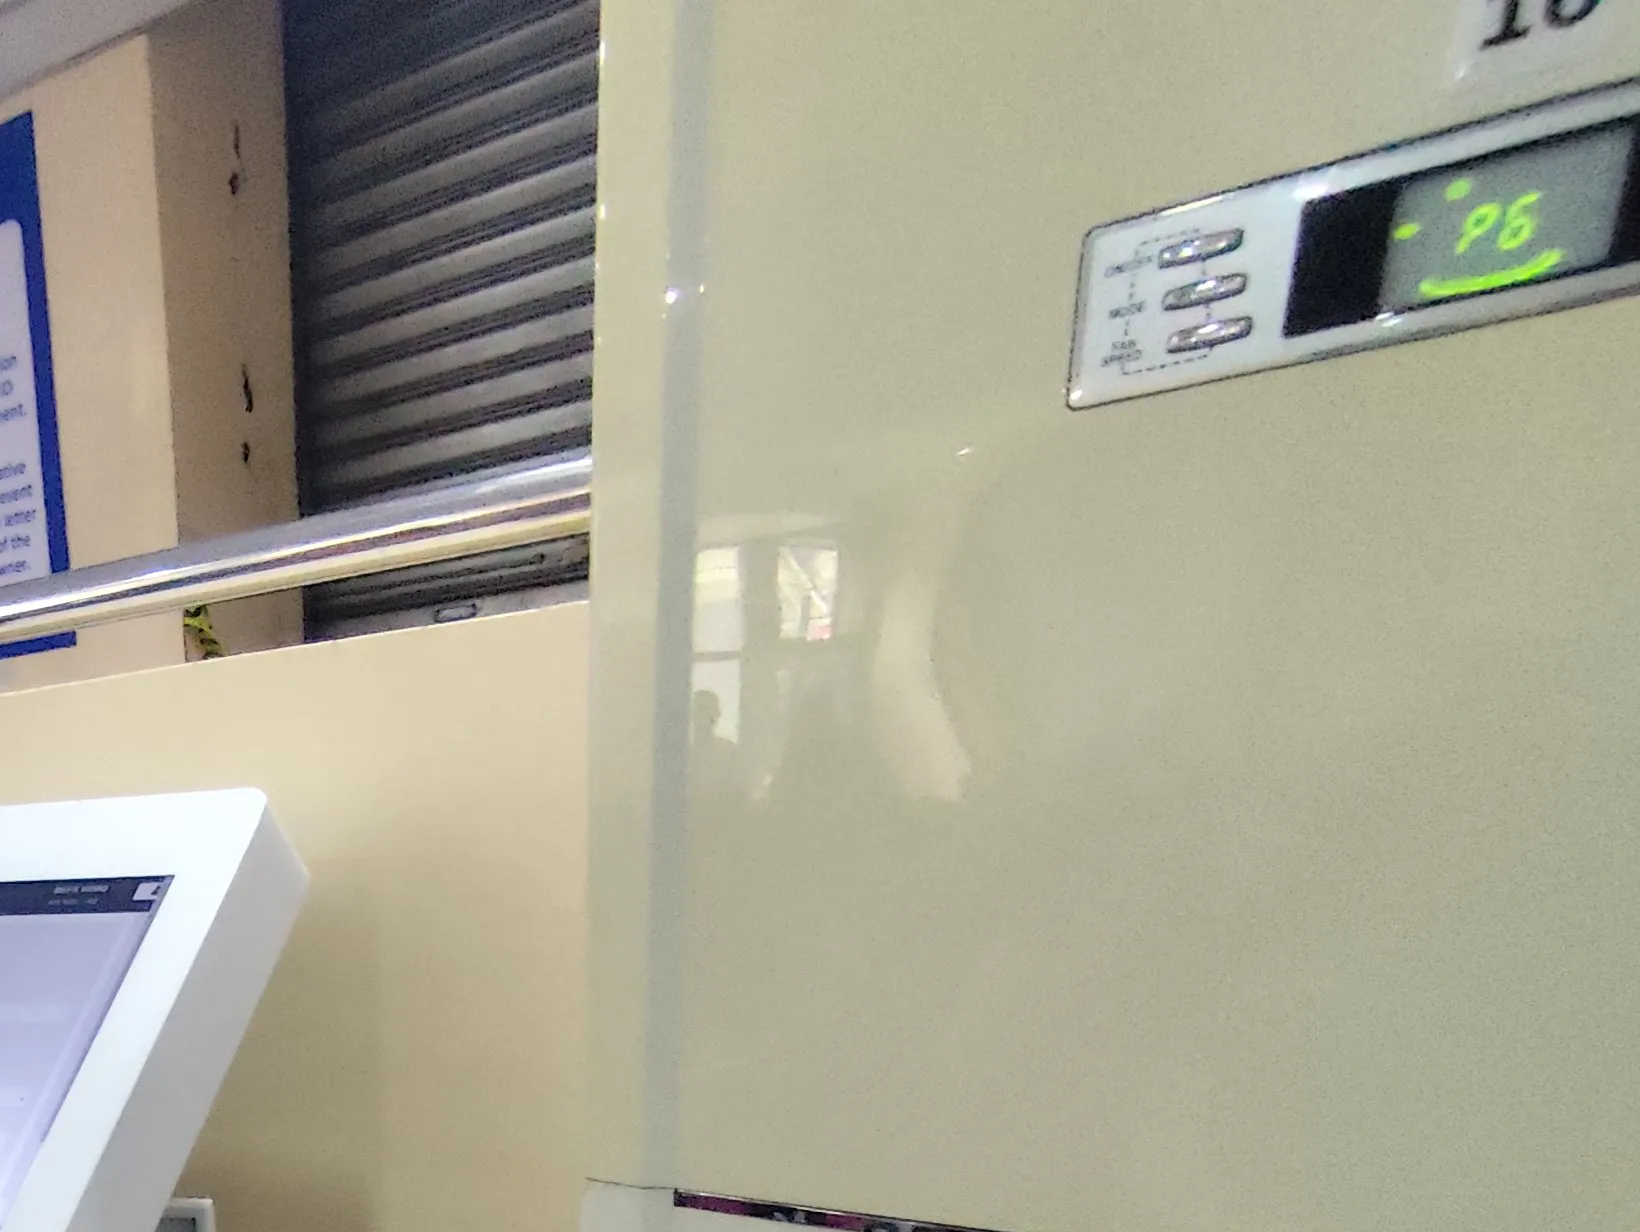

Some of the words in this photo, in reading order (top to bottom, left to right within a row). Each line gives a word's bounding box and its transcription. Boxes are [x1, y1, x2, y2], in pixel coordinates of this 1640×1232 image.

[1109, 301, 1145, 319] MODE
[1, 380, 14, 396] ID
[4, 509, 37, 526] letter
[11, 535, 31, 550] the
